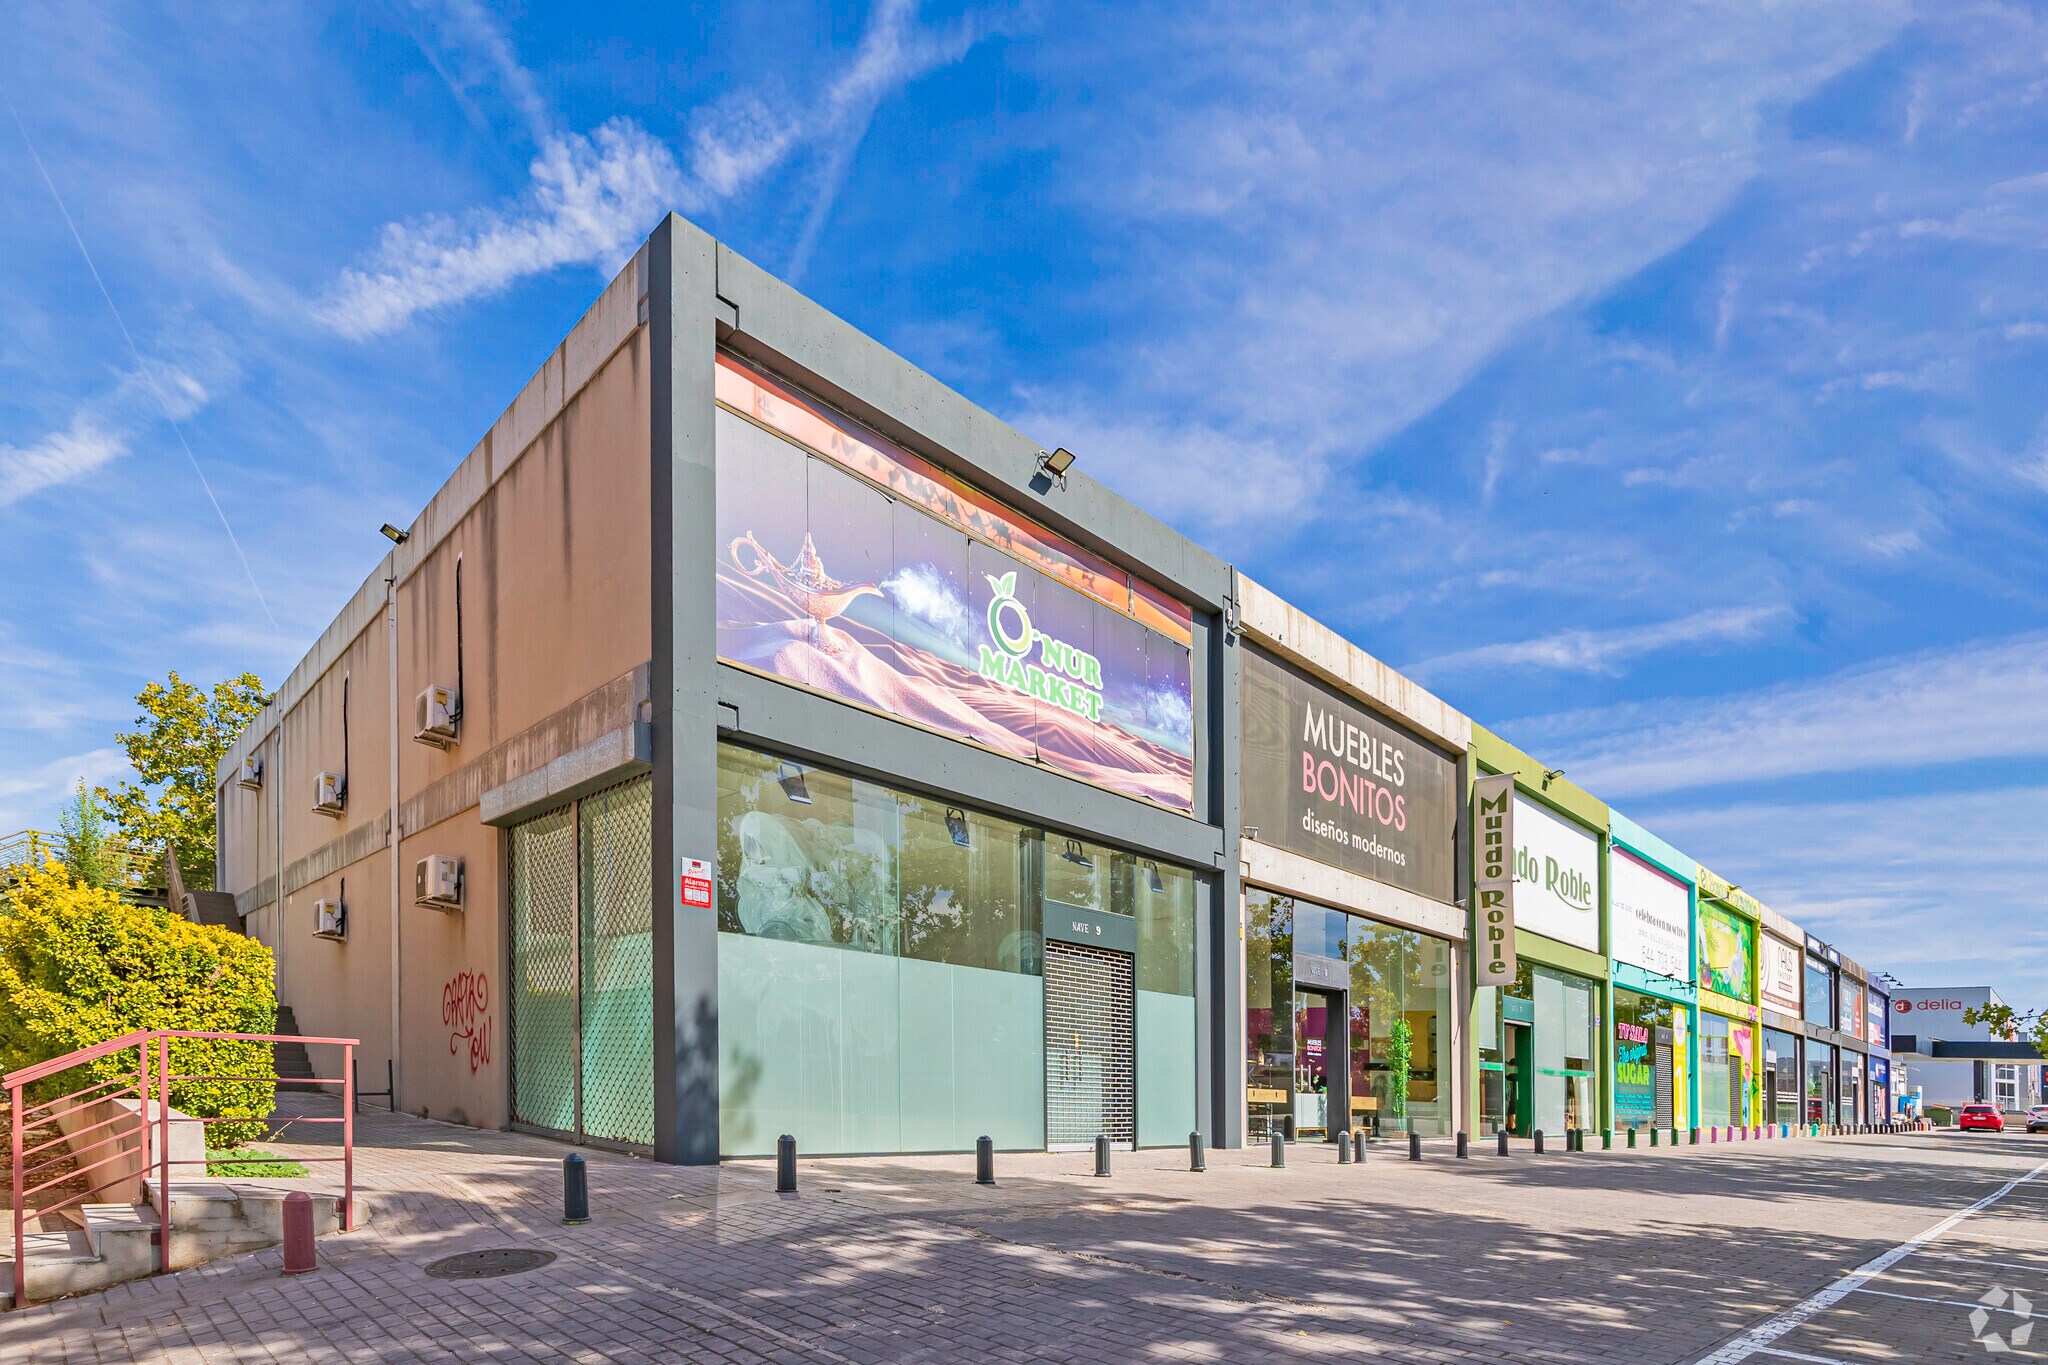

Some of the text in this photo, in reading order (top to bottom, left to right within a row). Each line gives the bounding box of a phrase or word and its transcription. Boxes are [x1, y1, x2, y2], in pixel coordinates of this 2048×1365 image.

[978, 644, 1104, 722] MARKET
[1303, 700, 1405, 787] MUEBLES
[1302, 750, 1406, 832] BONITOS
[1302, 808, 1406, 866] diseños modernos
[1480, 788, 1508, 878] Mundo
[684, 877, 709, 888] Alarma
[1545, 855, 1593, 911] Roble
[1072, 921, 1101, 936] NAVE 9
[1481, 889, 1508, 974] Roble
[1916, 998, 1962, 1011] delia
[1617, 1062, 1650, 1085] SUGAR
